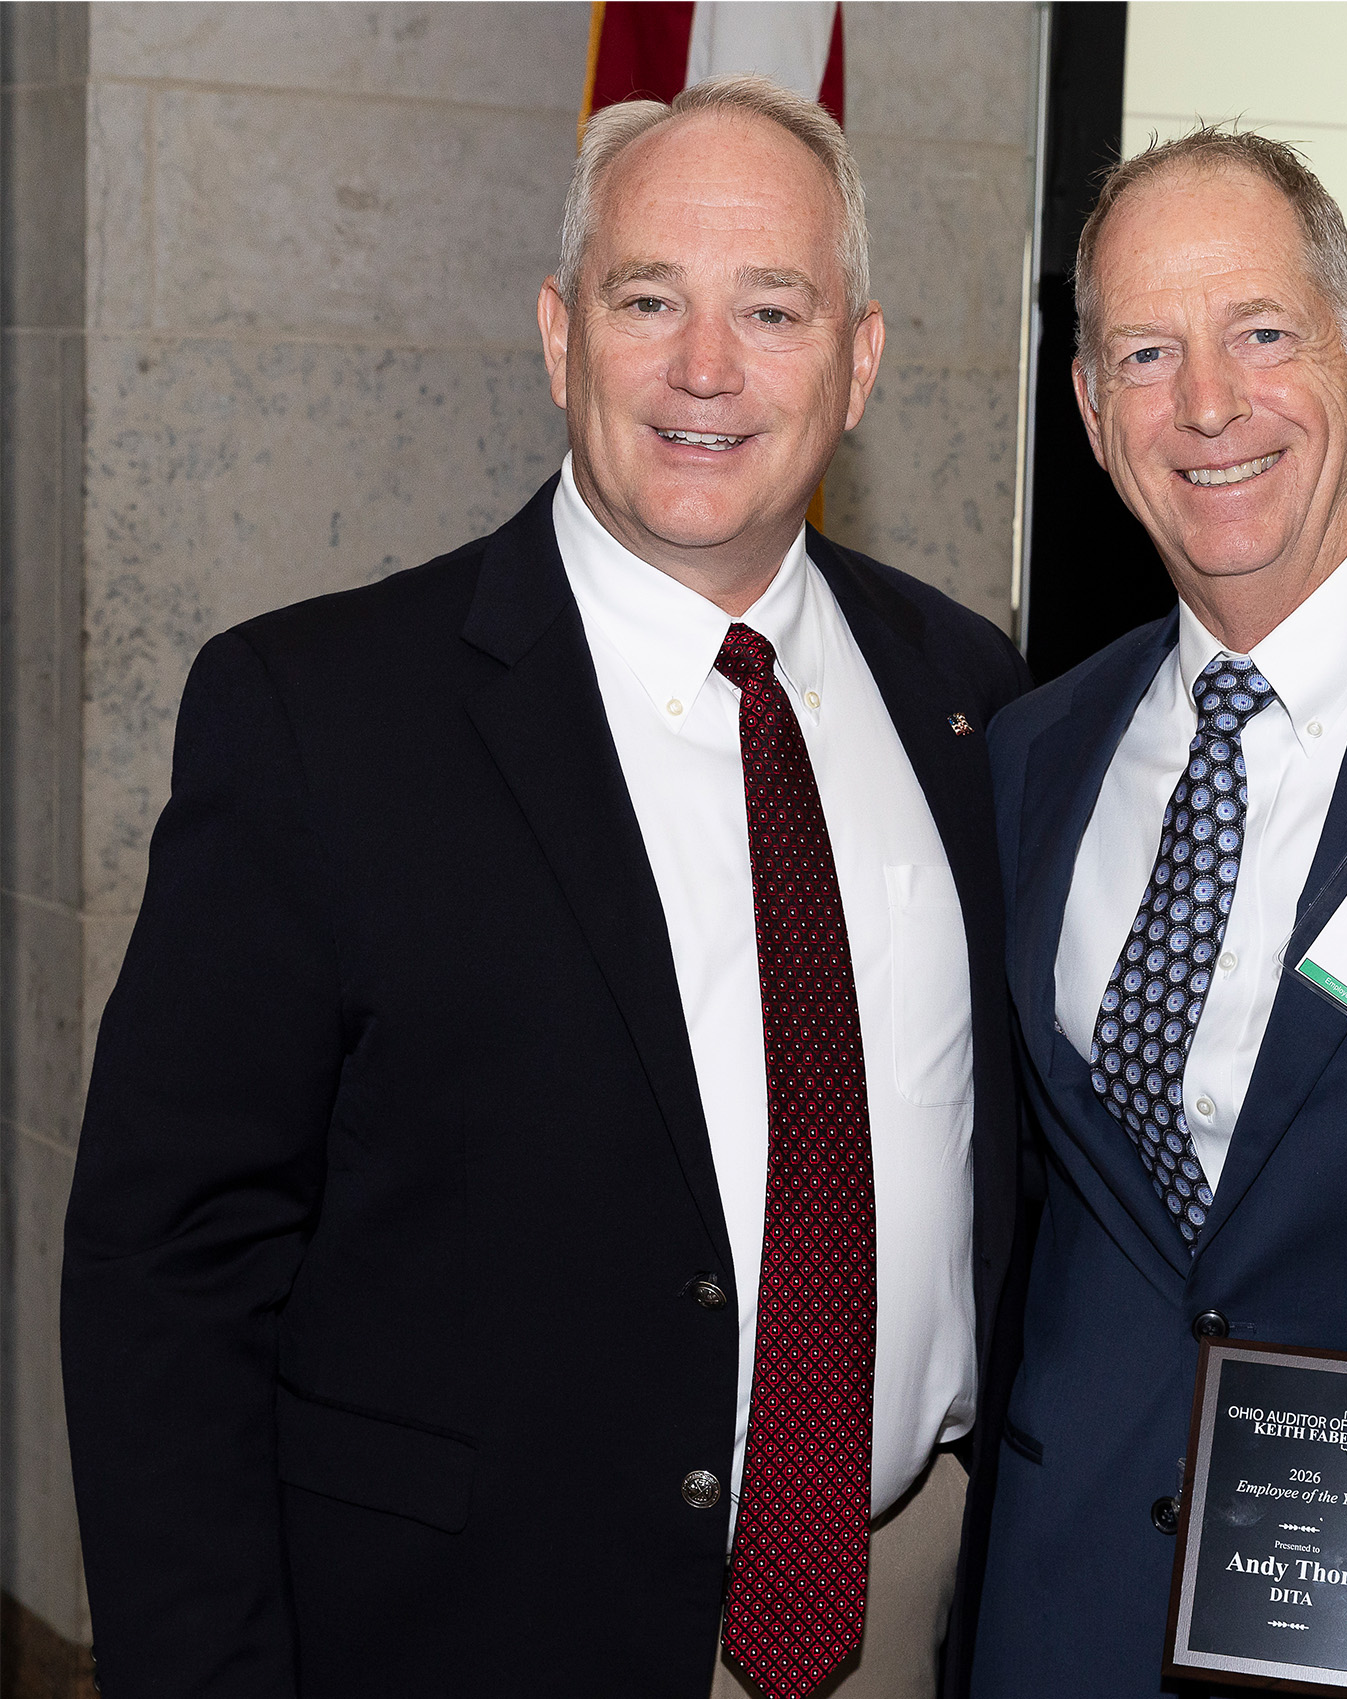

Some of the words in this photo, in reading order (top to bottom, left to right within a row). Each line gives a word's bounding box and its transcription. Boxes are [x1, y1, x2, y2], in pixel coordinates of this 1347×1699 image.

[1228, 1405, 1264, 1421] OHIO
[1266, 1410, 1327, 1429] AUDITOR
[1330, 1418, 1347, 1431] OF
[1253, 1422, 1306, 1440] KEITH
[1289, 1468, 1321, 1484] 2026
[1236, 1480, 1299, 1501] Employee
[1301, 1488, 1318, 1505] of
[1318, 1490, 1338, 1504] the
[1274, 1540, 1311, 1554] Presented
[1312, 1546, 1321, 1554] to
[1225, 1551, 1289, 1583] Andy
[1269, 1587, 1313, 1606] DITA
